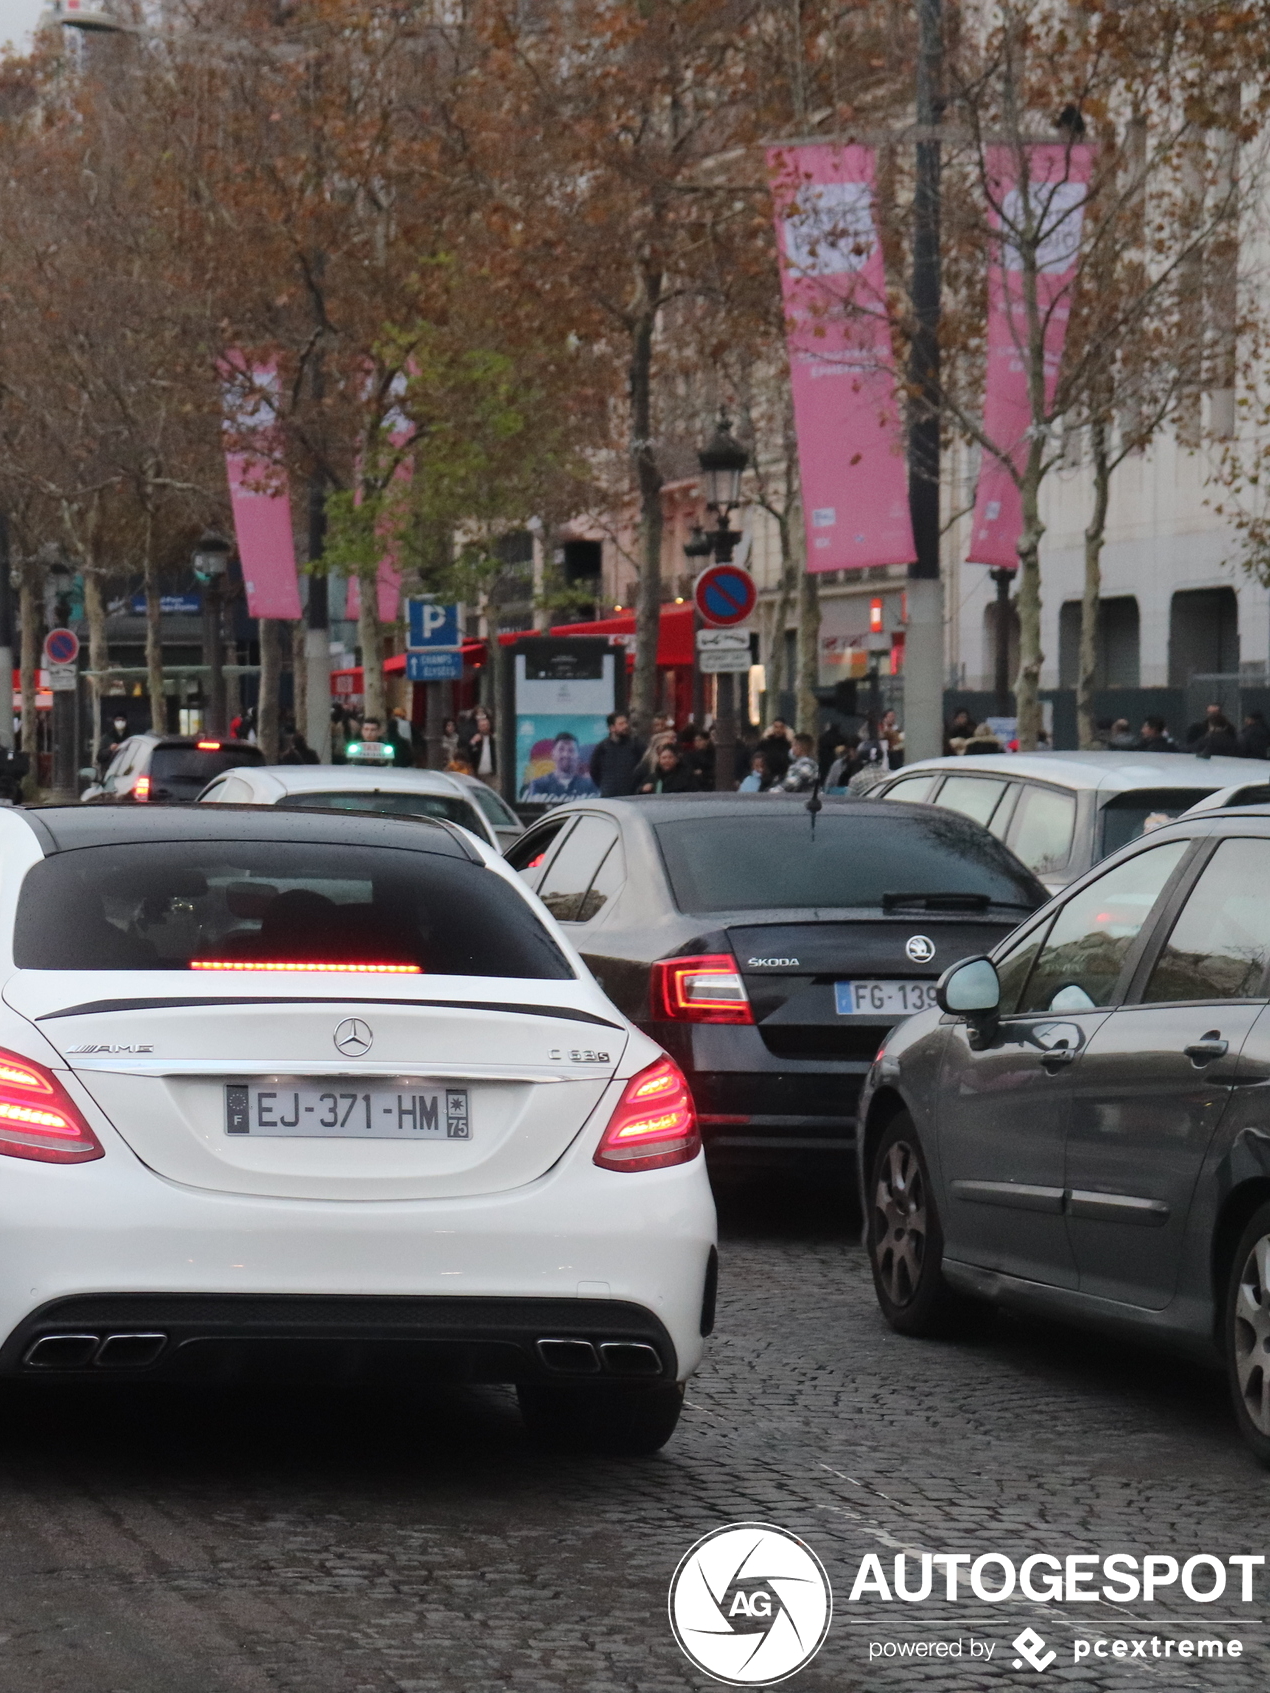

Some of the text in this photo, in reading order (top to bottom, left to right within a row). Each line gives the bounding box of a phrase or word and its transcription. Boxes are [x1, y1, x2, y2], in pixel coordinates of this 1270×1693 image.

[423, 604, 446, 638] P
[747, 957, 800, 967] ŠKODA
[92, 1044, 154, 1054] AMG
[256, 1092, 439, 1131] EJ-371-HM
[233, 1115, 243, 1126] F
[448, 1119, 468, 1136] 75
